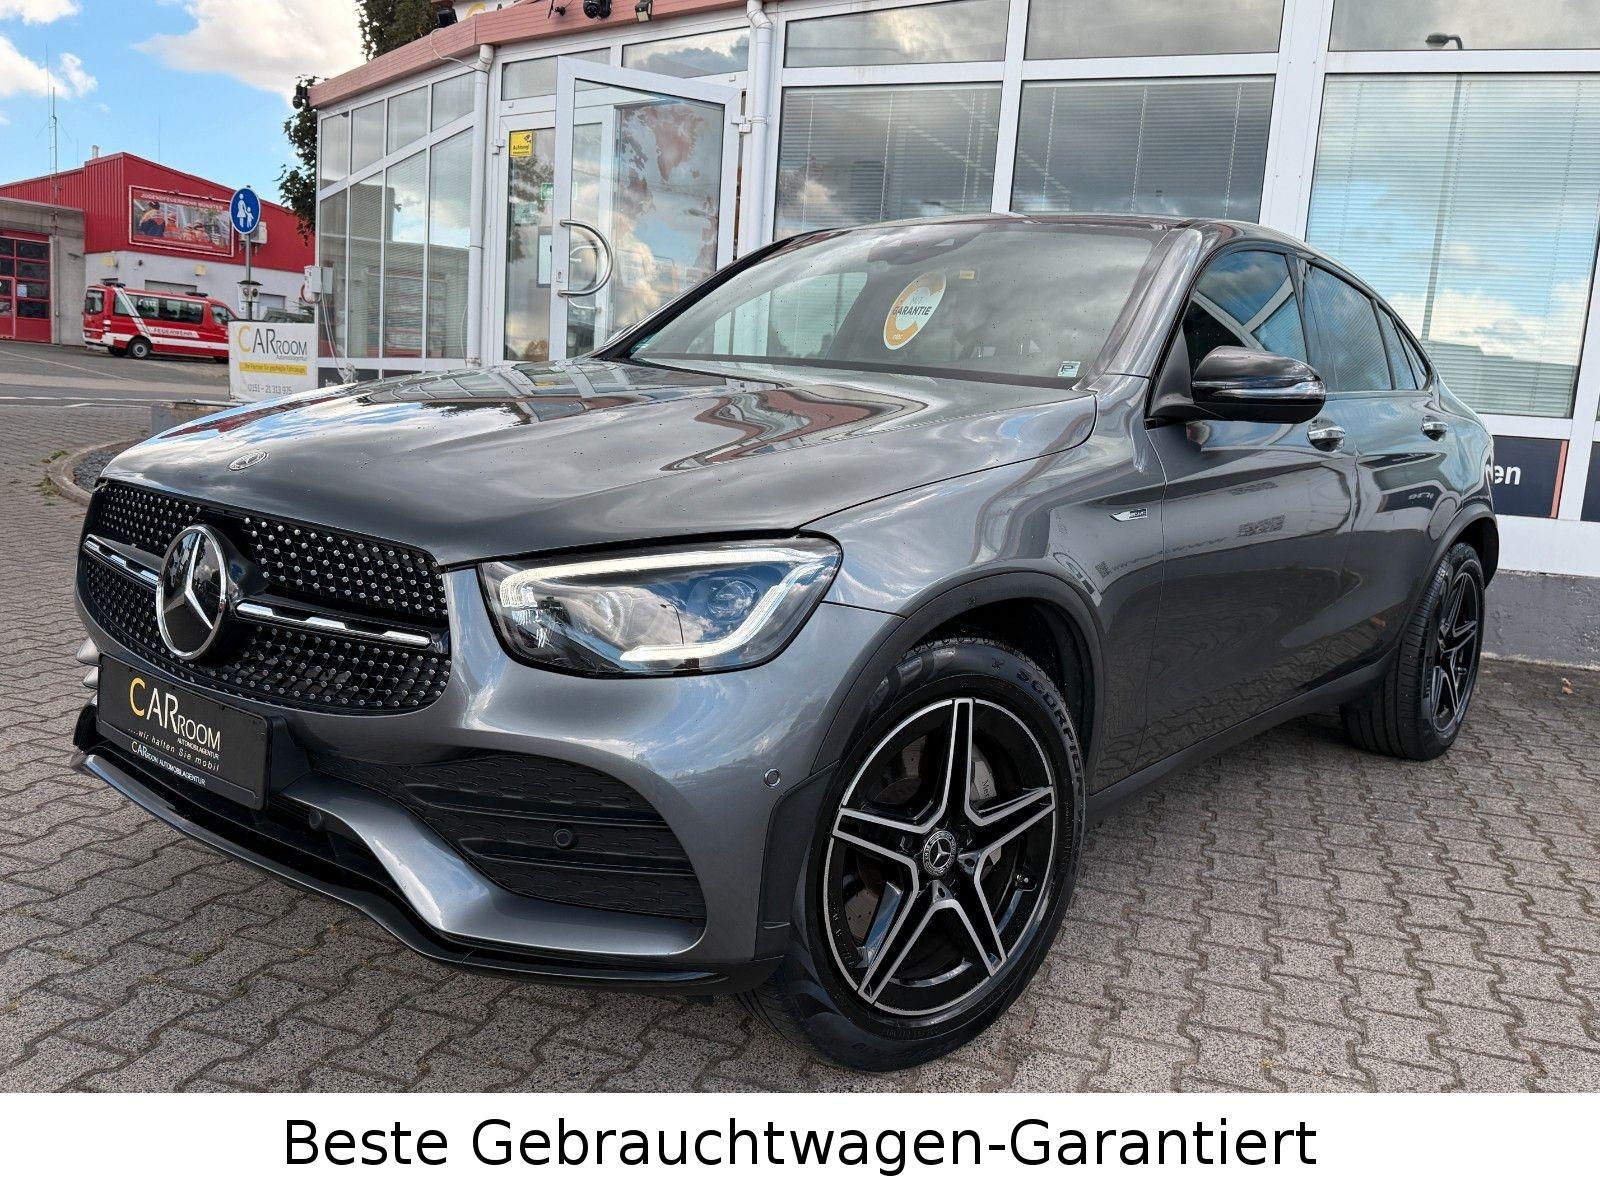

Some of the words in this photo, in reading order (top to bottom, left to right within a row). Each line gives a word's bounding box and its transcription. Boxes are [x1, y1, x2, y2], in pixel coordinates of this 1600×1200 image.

[892, 306, 932, 316] GARANTIE
[152, 328, 194, 337] FEUERWEHR
[176, 737, 220, 761] AUTOMOBILAGENTUR
[178, 748, 192, 761] Sie
[194, 757, 220, 772] mobil
[158, 759, 207, 786] AUTOMOBILAGENTUR
